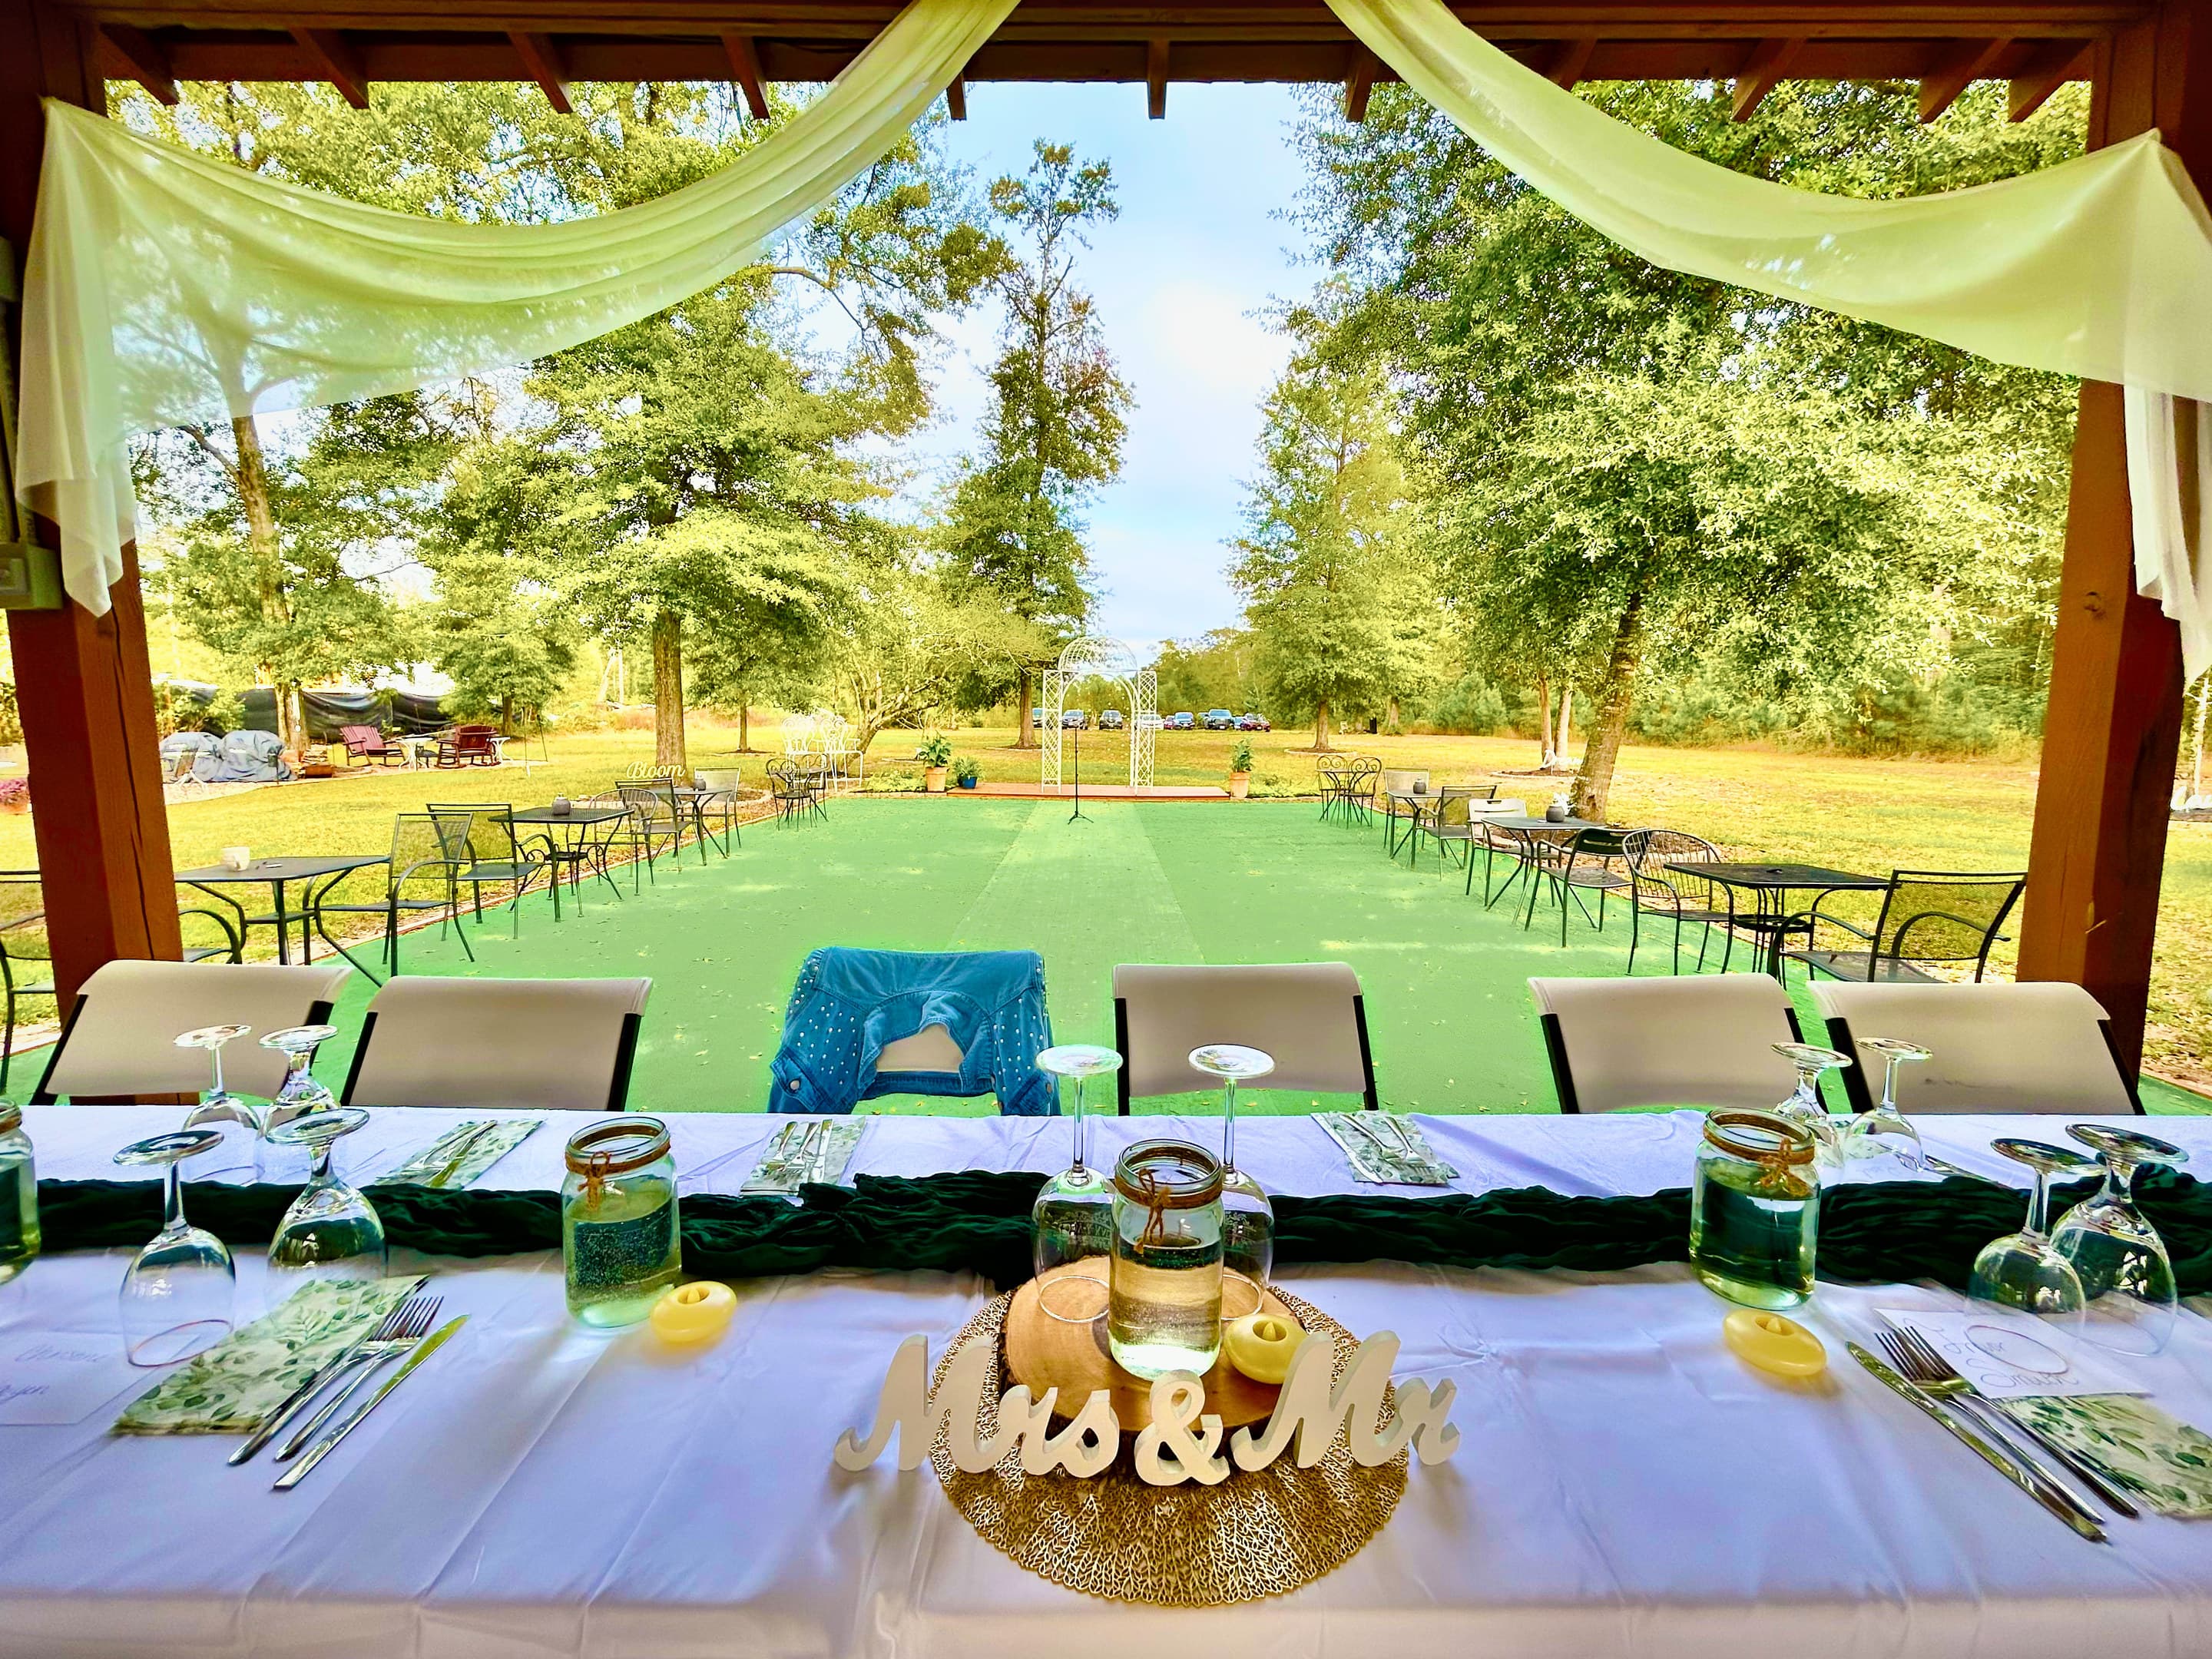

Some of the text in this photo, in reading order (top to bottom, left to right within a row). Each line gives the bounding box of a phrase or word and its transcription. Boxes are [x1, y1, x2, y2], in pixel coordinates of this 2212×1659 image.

[833, 1330, 1460, 1487] Mrs & Mr
